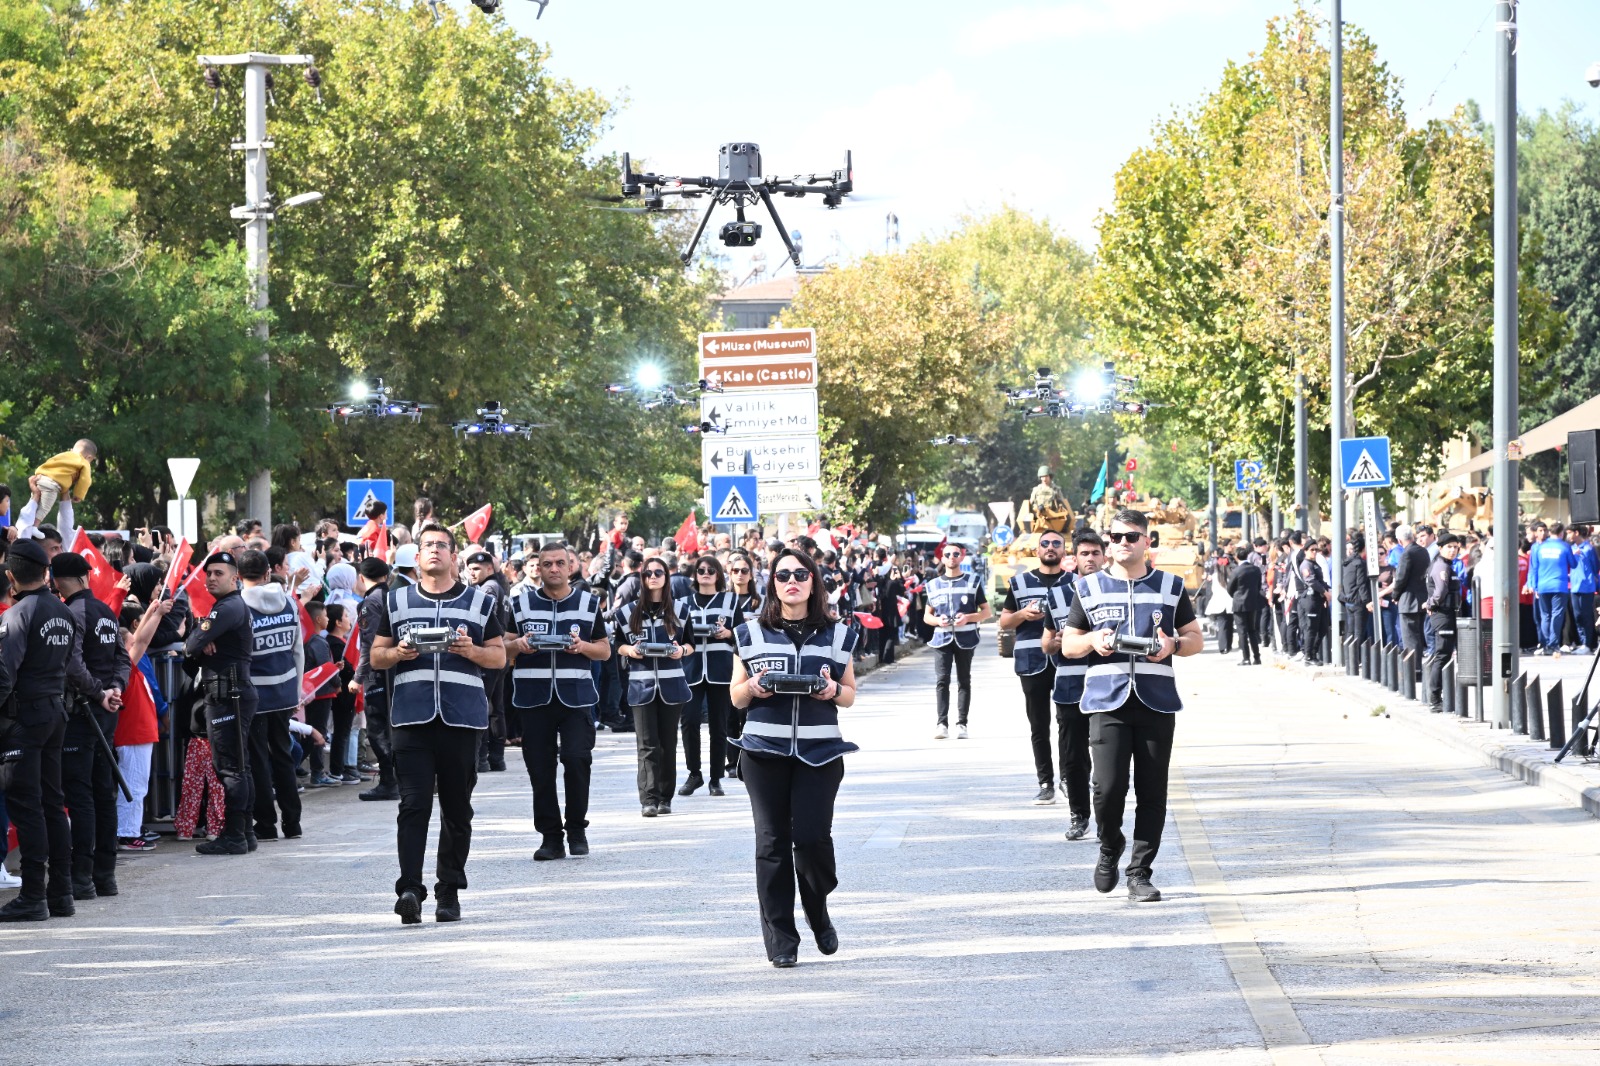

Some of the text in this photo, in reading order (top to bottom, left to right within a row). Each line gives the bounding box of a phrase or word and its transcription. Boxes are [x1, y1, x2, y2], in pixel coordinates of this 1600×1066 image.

[721, 338, 810, 352] Müze (Museum)
[723, 368, 812, 383] Kale (Castle)
[725, 401, 775, 412] Valilik
[725, 418, 783, 429] Emniyet
[726, 444, 806, 456] Büükşehir
[727, 459, 810, 474] Beediyesi
[753, 661, 783, 672] POLIS
